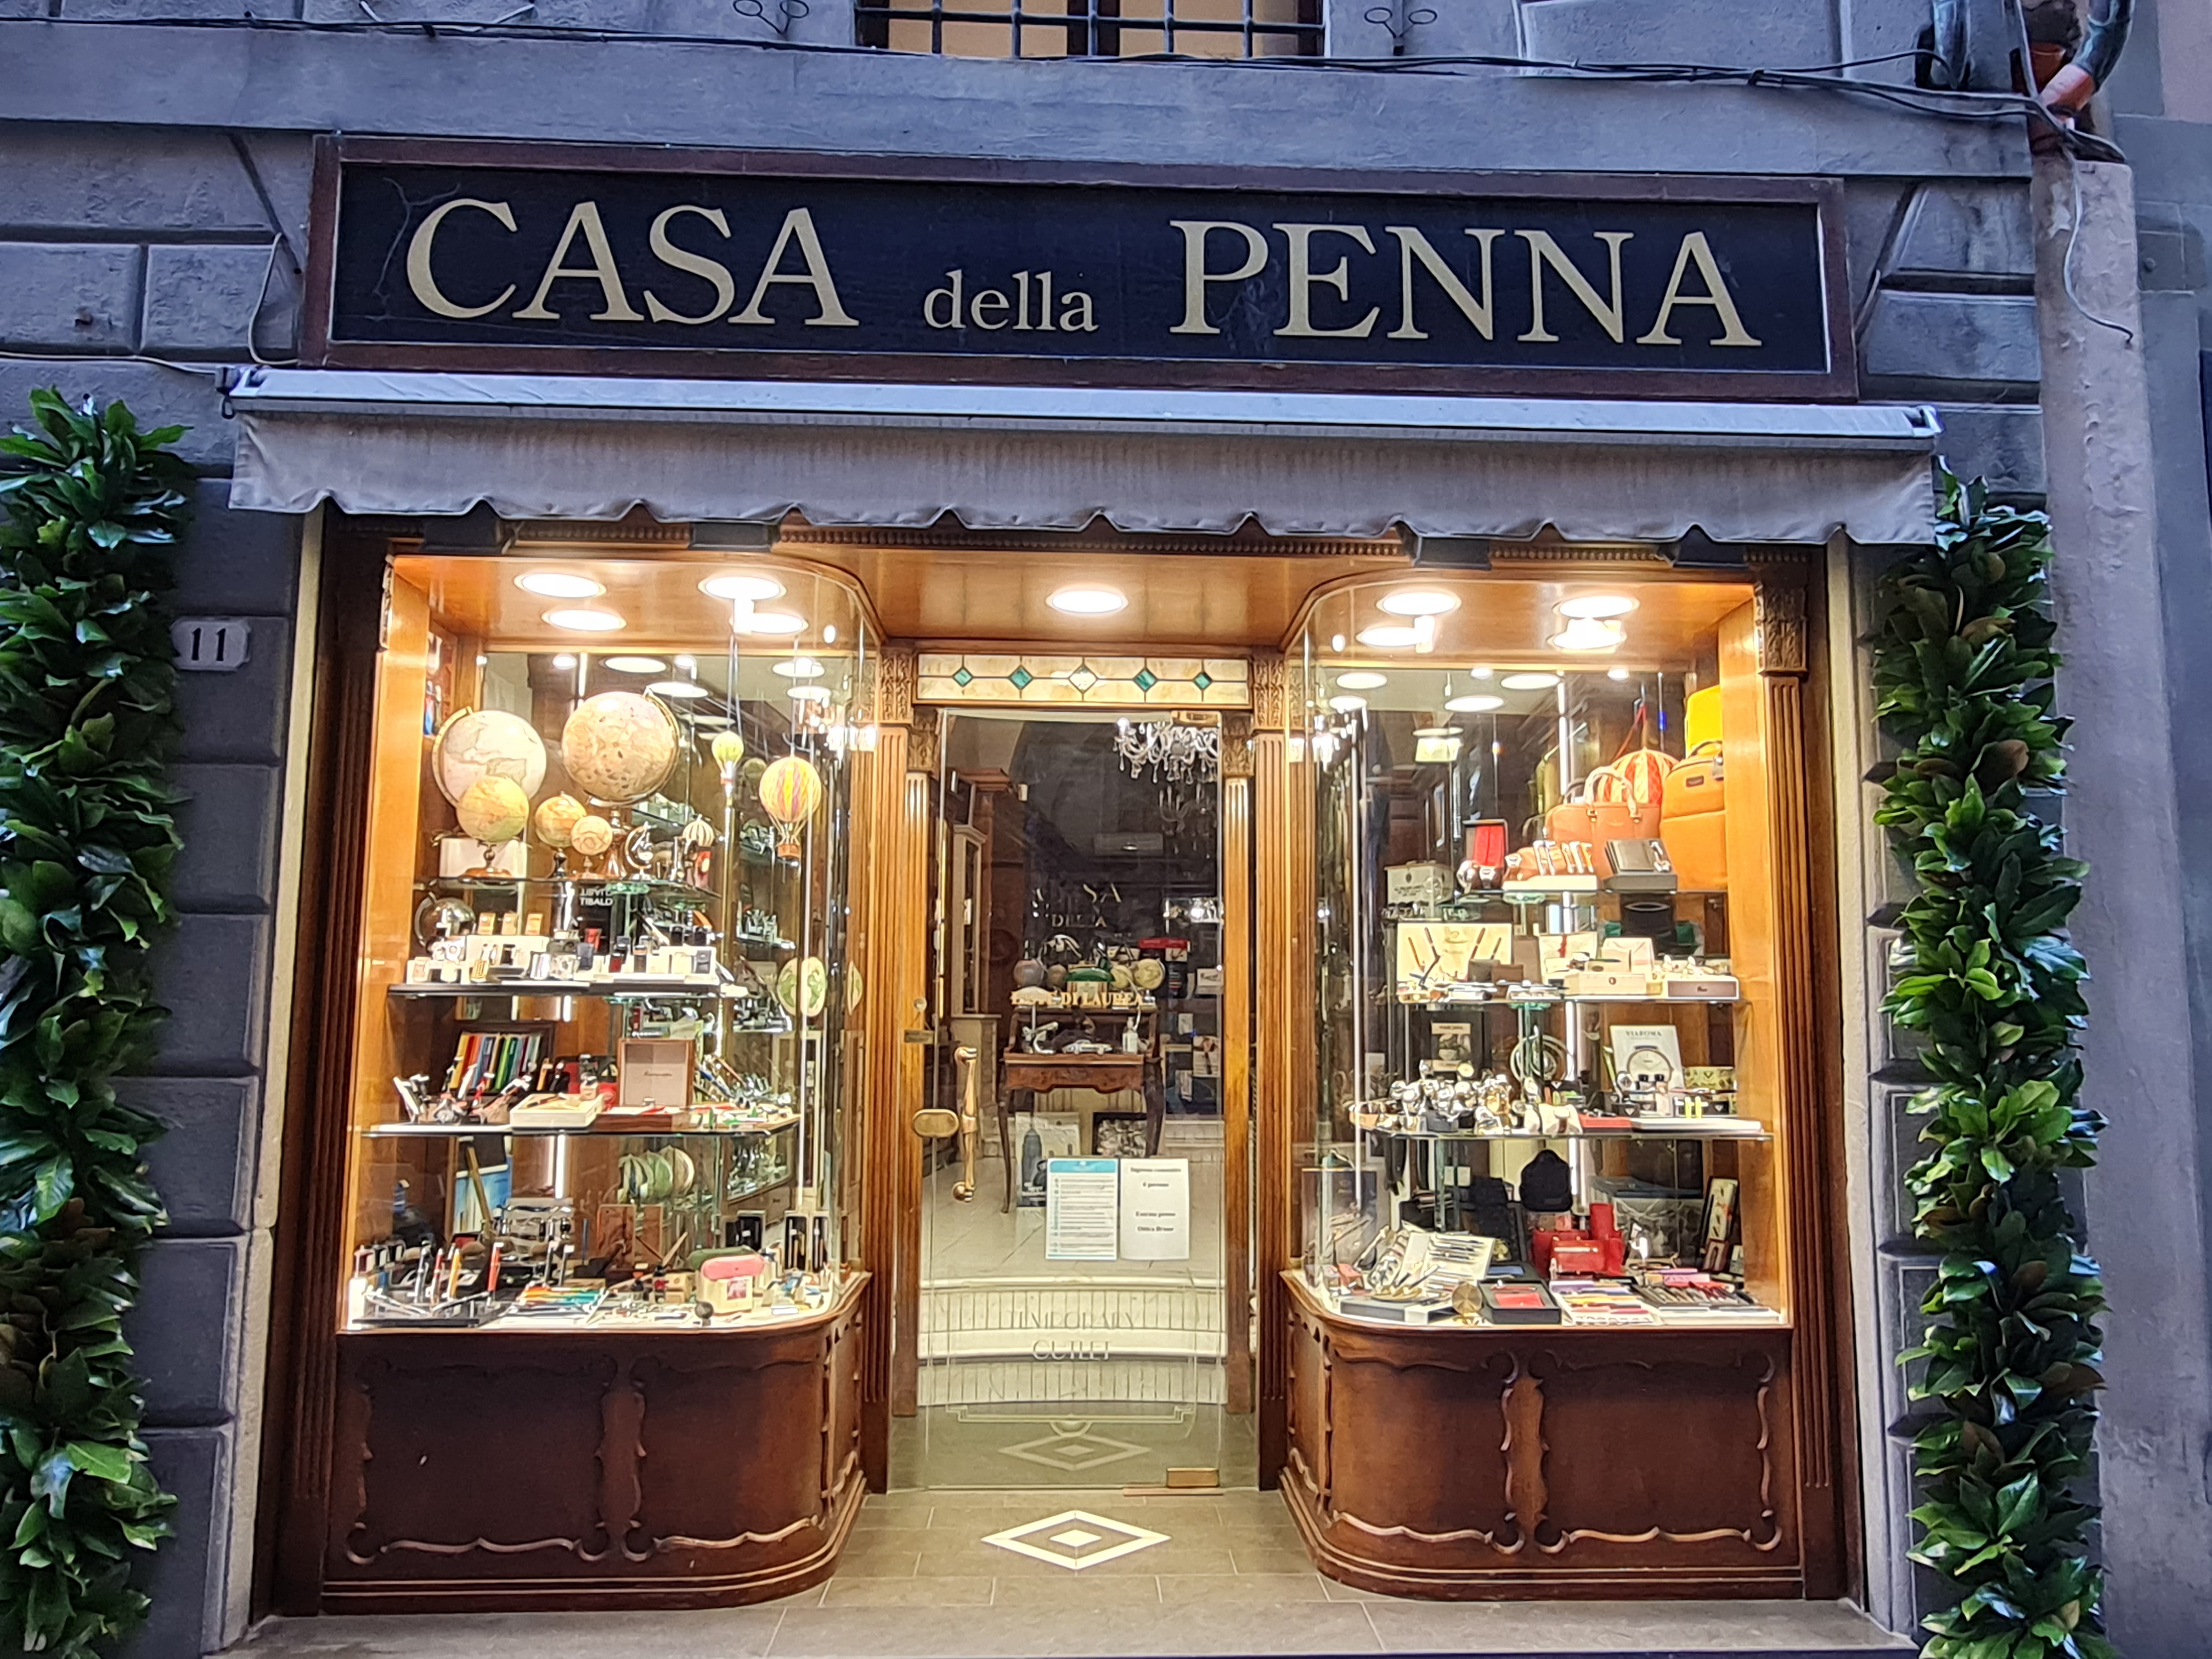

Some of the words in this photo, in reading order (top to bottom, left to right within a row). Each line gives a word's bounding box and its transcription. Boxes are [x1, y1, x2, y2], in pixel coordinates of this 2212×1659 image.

[406, 197, 860, 328] CASA
[923, 269, 1099, 333] della
[1169, 218, 1763, 348] PENNA
[191, 627, 227, 662] 11
